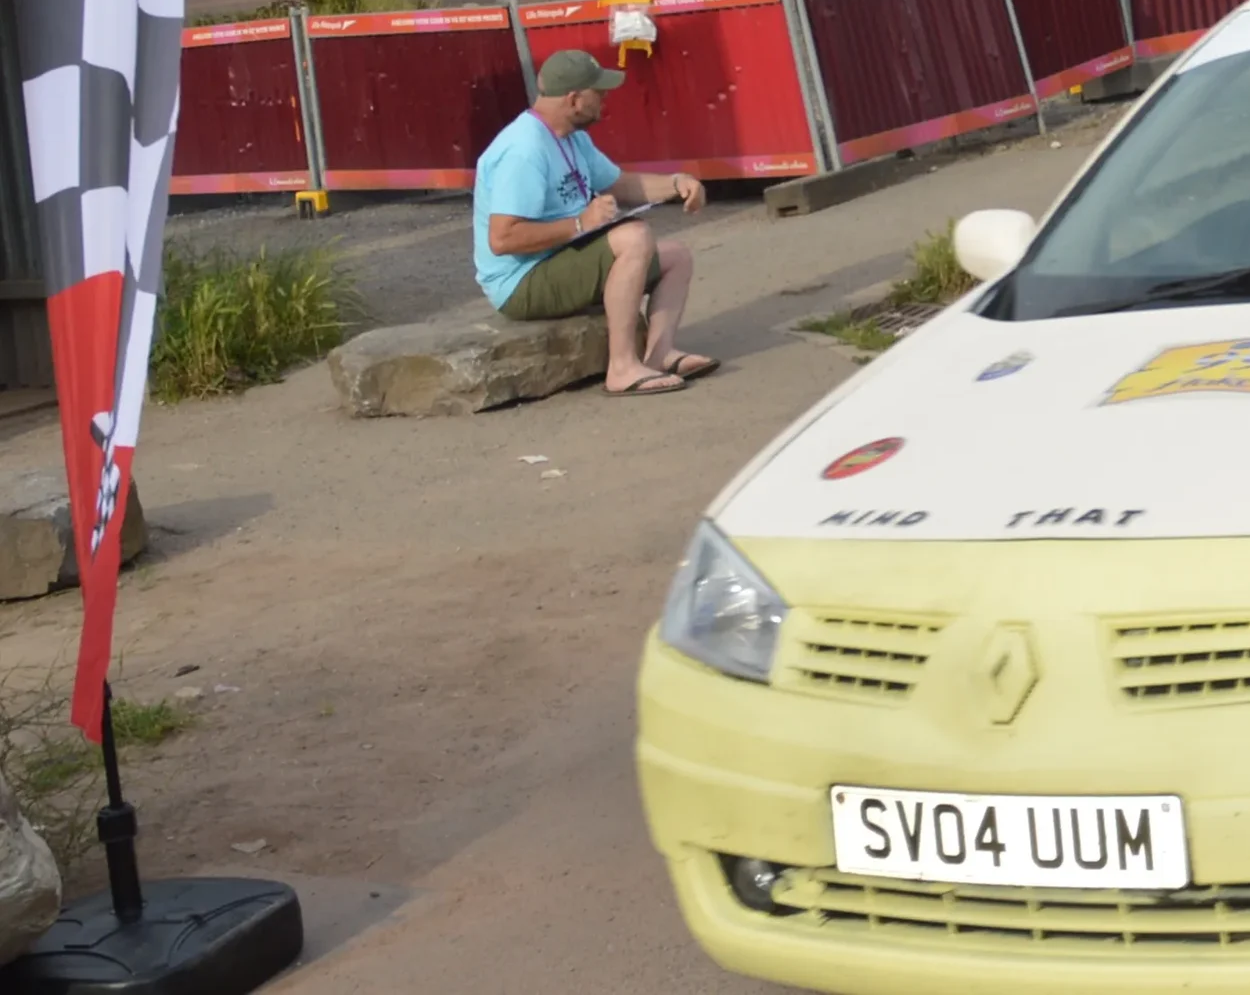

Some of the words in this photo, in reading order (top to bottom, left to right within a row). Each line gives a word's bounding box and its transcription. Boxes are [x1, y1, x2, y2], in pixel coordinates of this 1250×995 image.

[818, 508, 930, 527] MIND
[1005, 506, 1147, 528] THAT
[859, 798, 1006, 867] SV04
[1027, 806, 1154, 871] UUM
